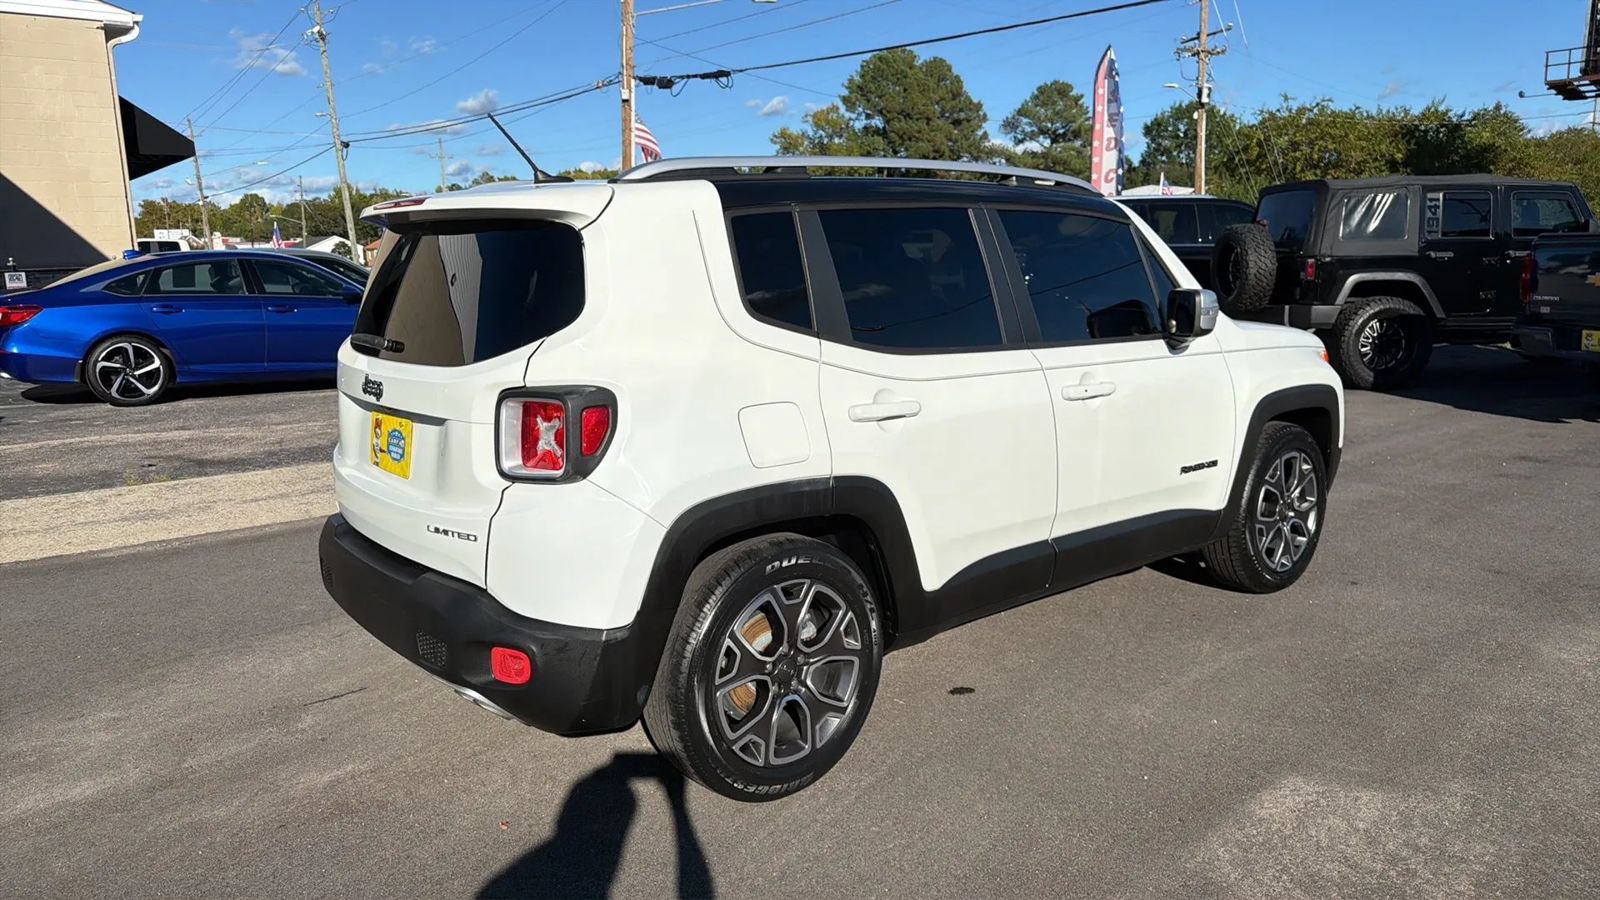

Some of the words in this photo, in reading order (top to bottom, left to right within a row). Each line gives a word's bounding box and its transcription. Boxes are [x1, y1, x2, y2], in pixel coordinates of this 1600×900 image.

[1426, 198, 1440, 235] 1941
[362, 373, 384, 402] Jeep
[426, 524, 478, 542] LIMITED
